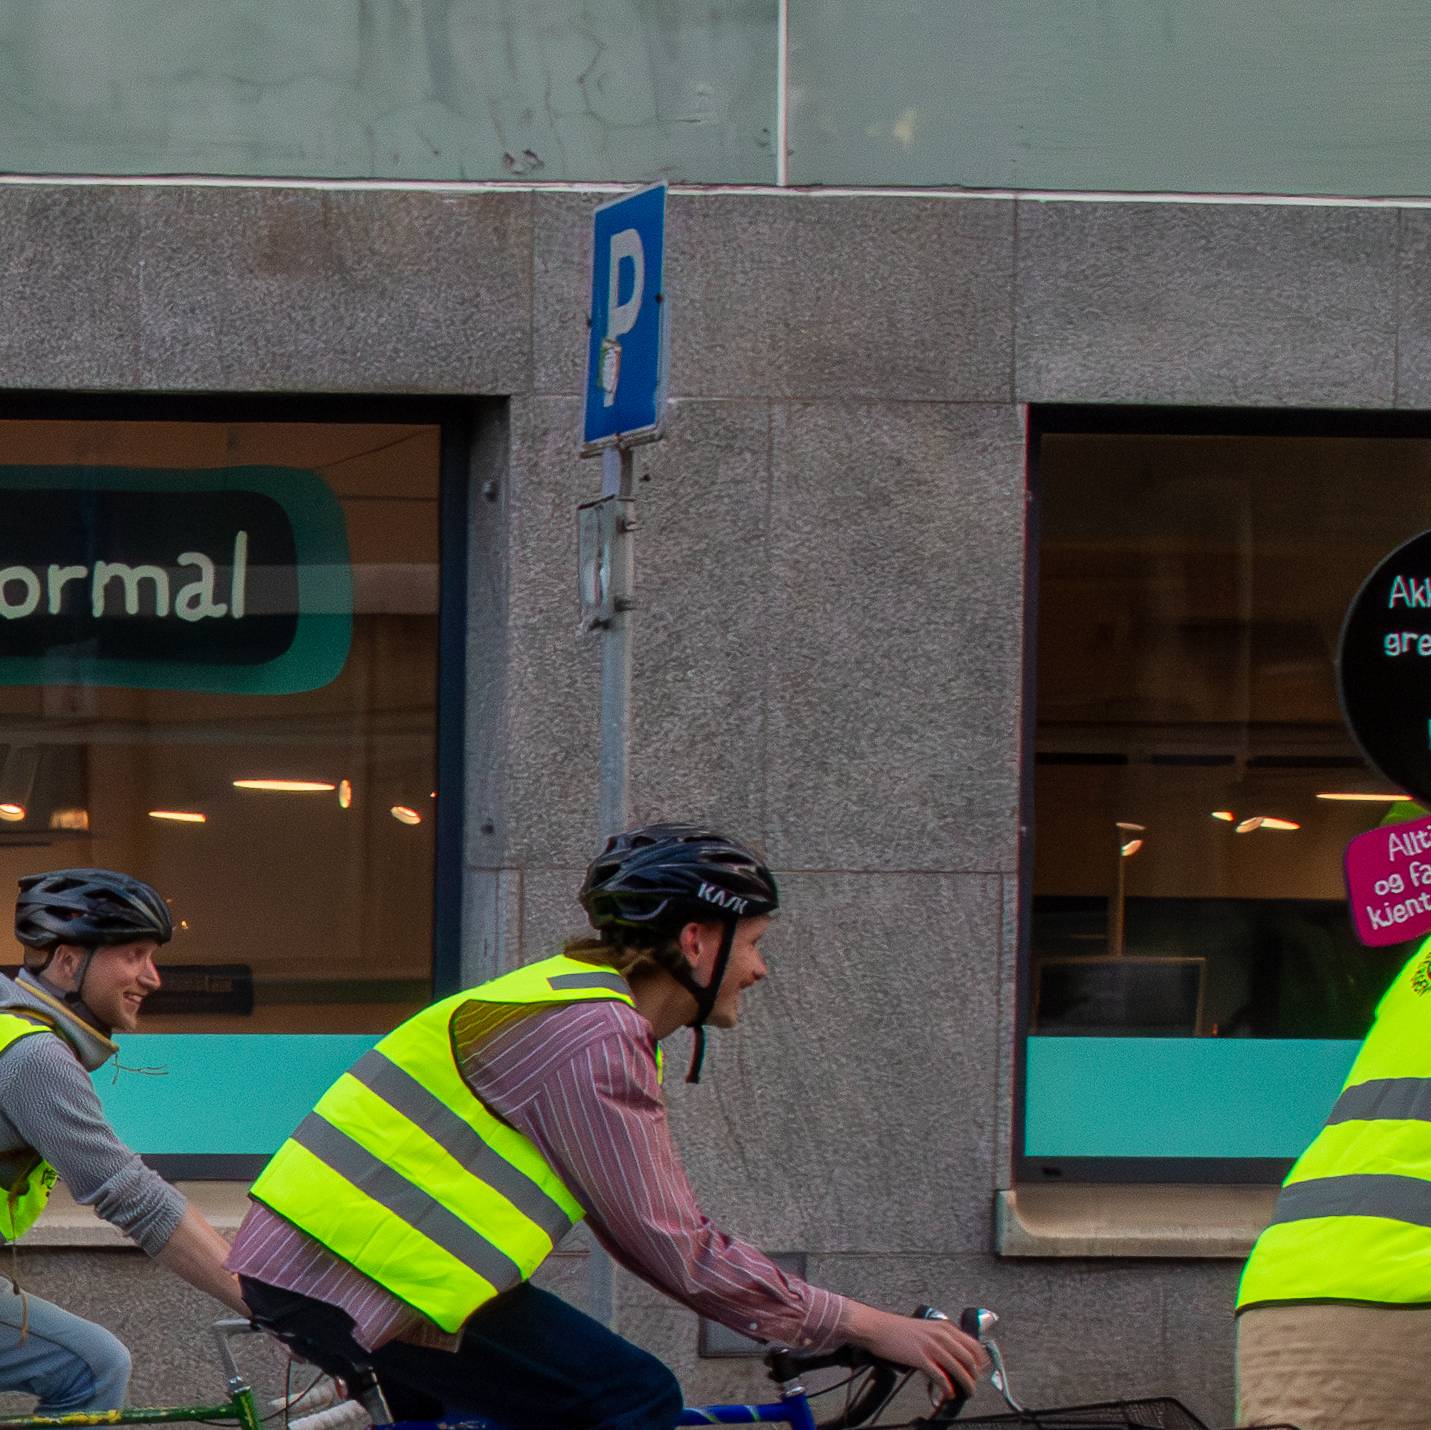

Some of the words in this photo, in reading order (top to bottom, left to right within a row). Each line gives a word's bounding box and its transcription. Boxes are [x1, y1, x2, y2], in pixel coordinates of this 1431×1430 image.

[603, 228, 645, 407] P
[697, 881, 749, 915] KASK
[1374, 873, 1405, 896] og
